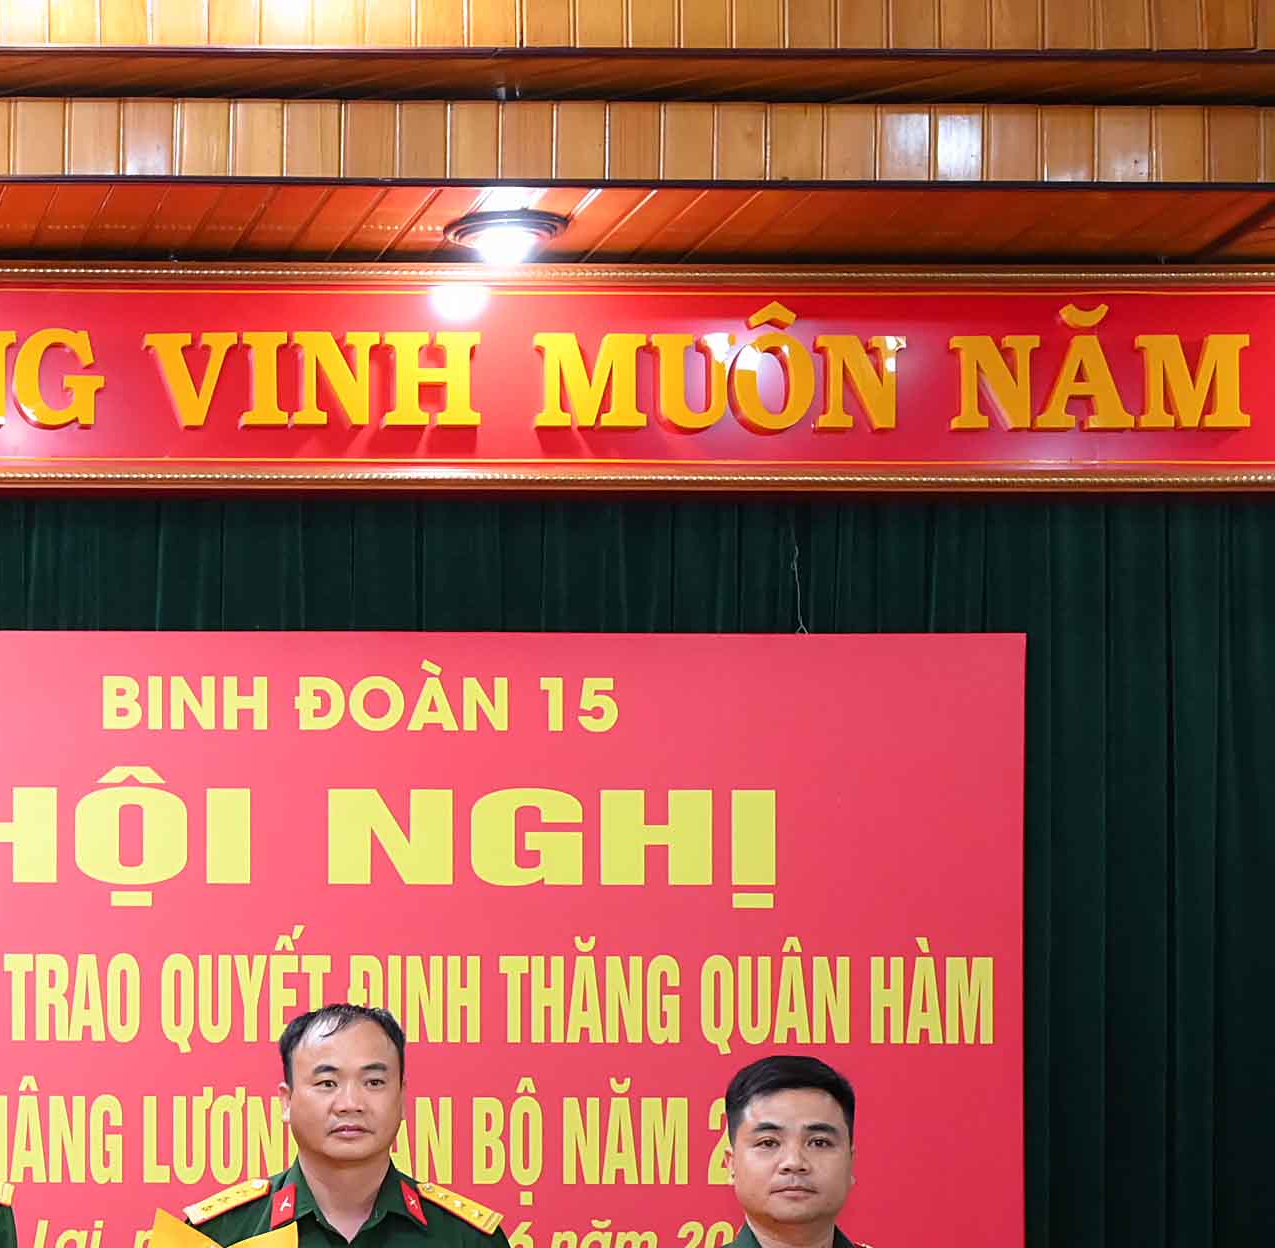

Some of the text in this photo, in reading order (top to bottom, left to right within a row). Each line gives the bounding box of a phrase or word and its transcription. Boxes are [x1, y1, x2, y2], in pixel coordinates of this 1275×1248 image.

[144, 330, 482, 428] VINH
[533, 301, 907, 432] MUÔN
[949, 303, 1252, 430] NĂM
[102, 659, 619, 733] BINH ĐOÀN 15
[327, 788, 776, 909] NGHỊ
[3, 953, 141, 1043] TRAO
[161, 925, 332, 1053] QUYẾT
[499, 936, 682, 1045] THĂNG
[700, 936, 851, 1054] QUÂN
[870, 936, 995, 1045] HÀM
[142, 1086, 299, 1185] LƯƠN
[472, 1077, 544, 1206] BỘ
[562, 1077, 689, 1185] NĂM
